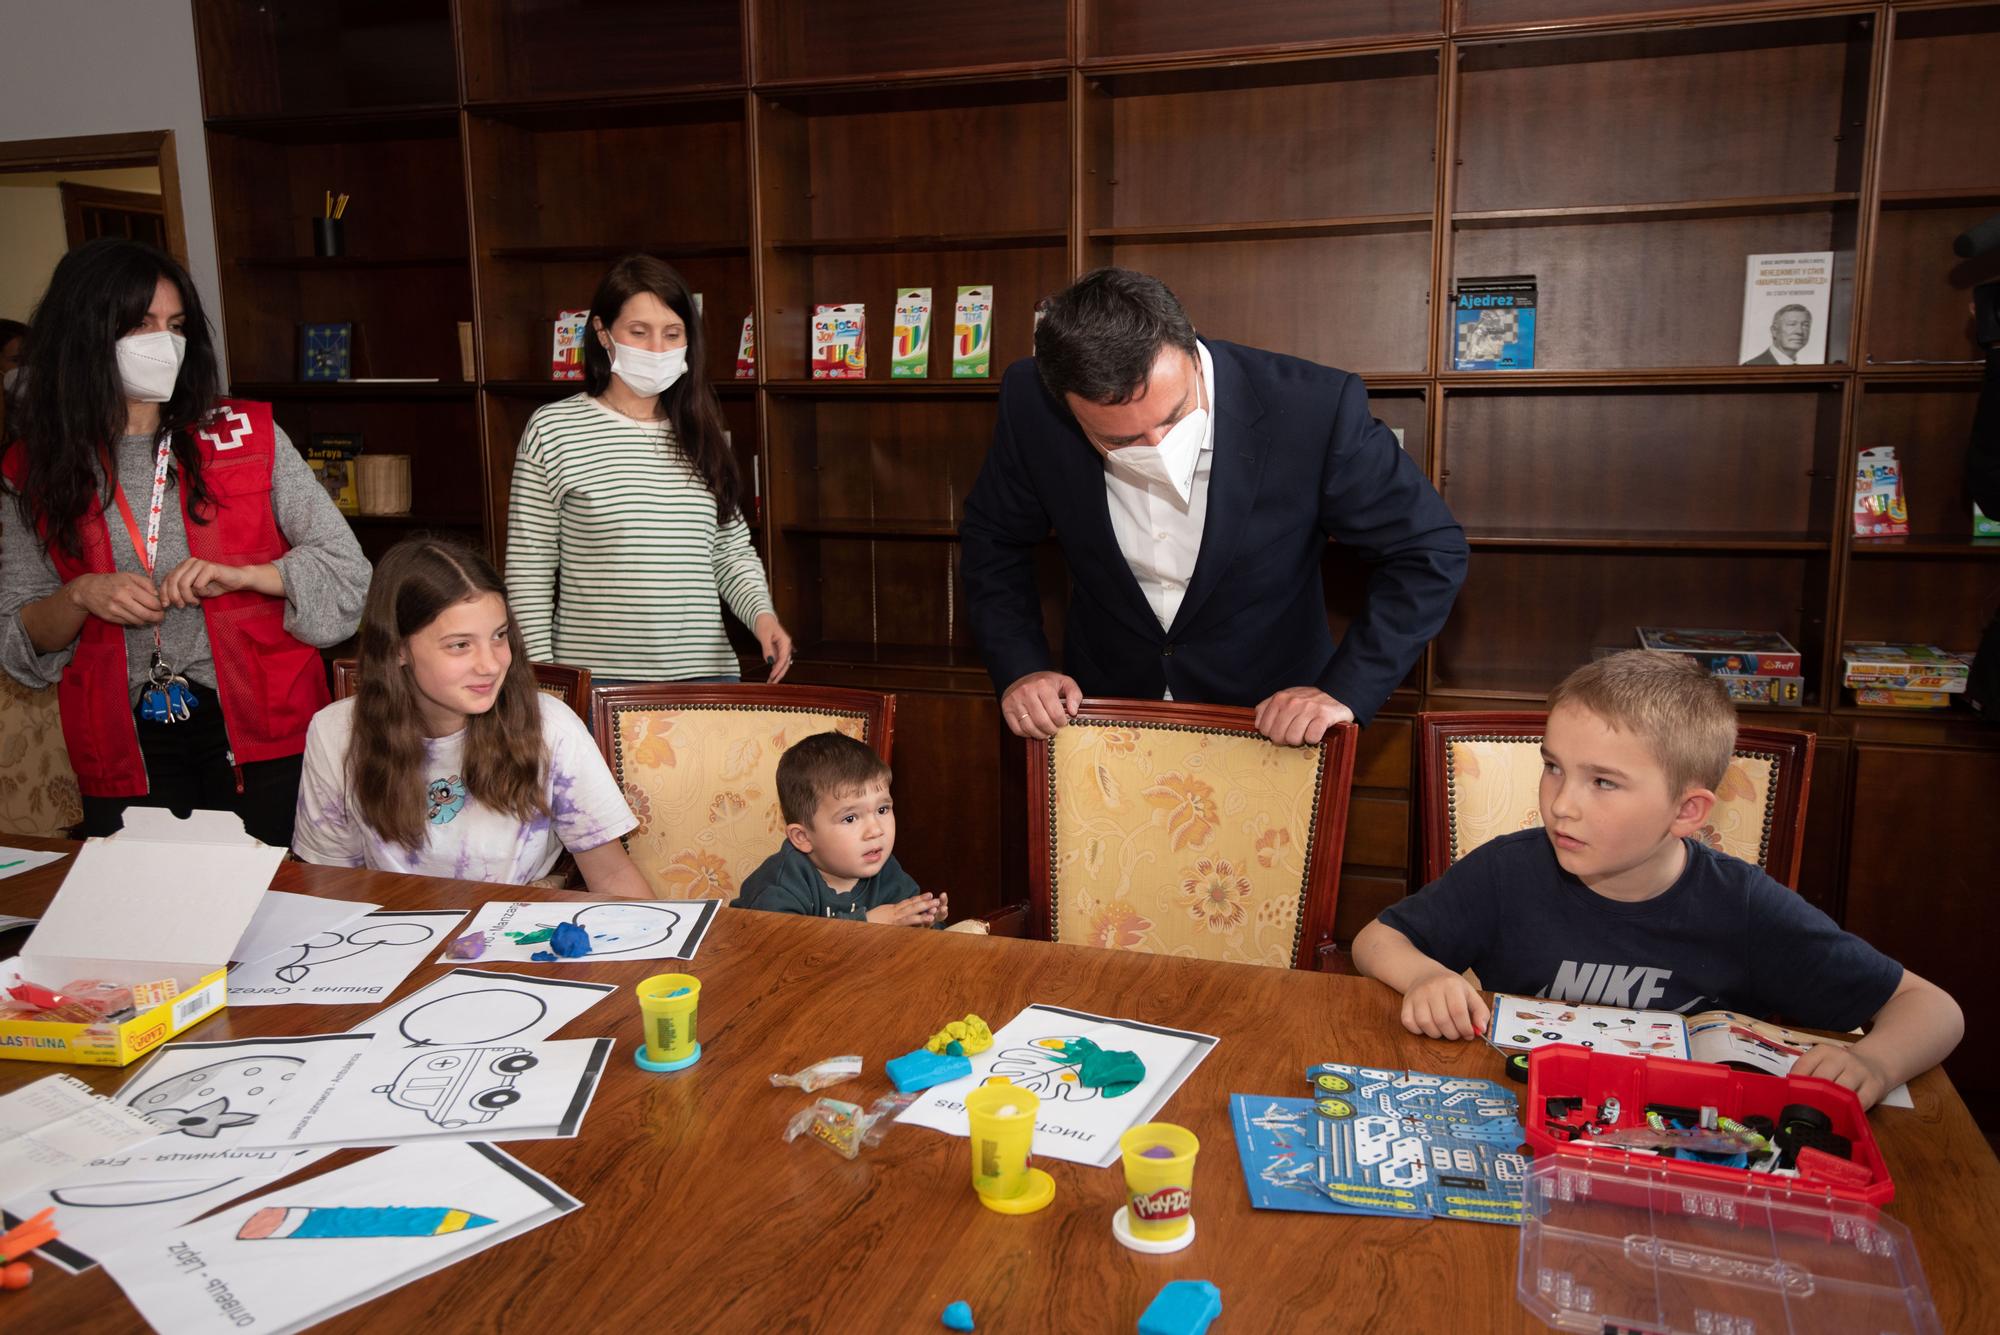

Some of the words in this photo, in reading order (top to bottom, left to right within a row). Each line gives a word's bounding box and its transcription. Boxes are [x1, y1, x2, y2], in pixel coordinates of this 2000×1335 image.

[1459, 294, 1513, 309] Ajedrez
[322, 449, 342, 460] raya
[312, 986, 384, 994] Вишня
[1549, 960, 1673, 1008] NIKE
[0, 1036, 66, 1048] LASTILINA
[1035, 1121, 1096, 1142] лист
[1134, 1191, 1190, 1217] Play-Do
